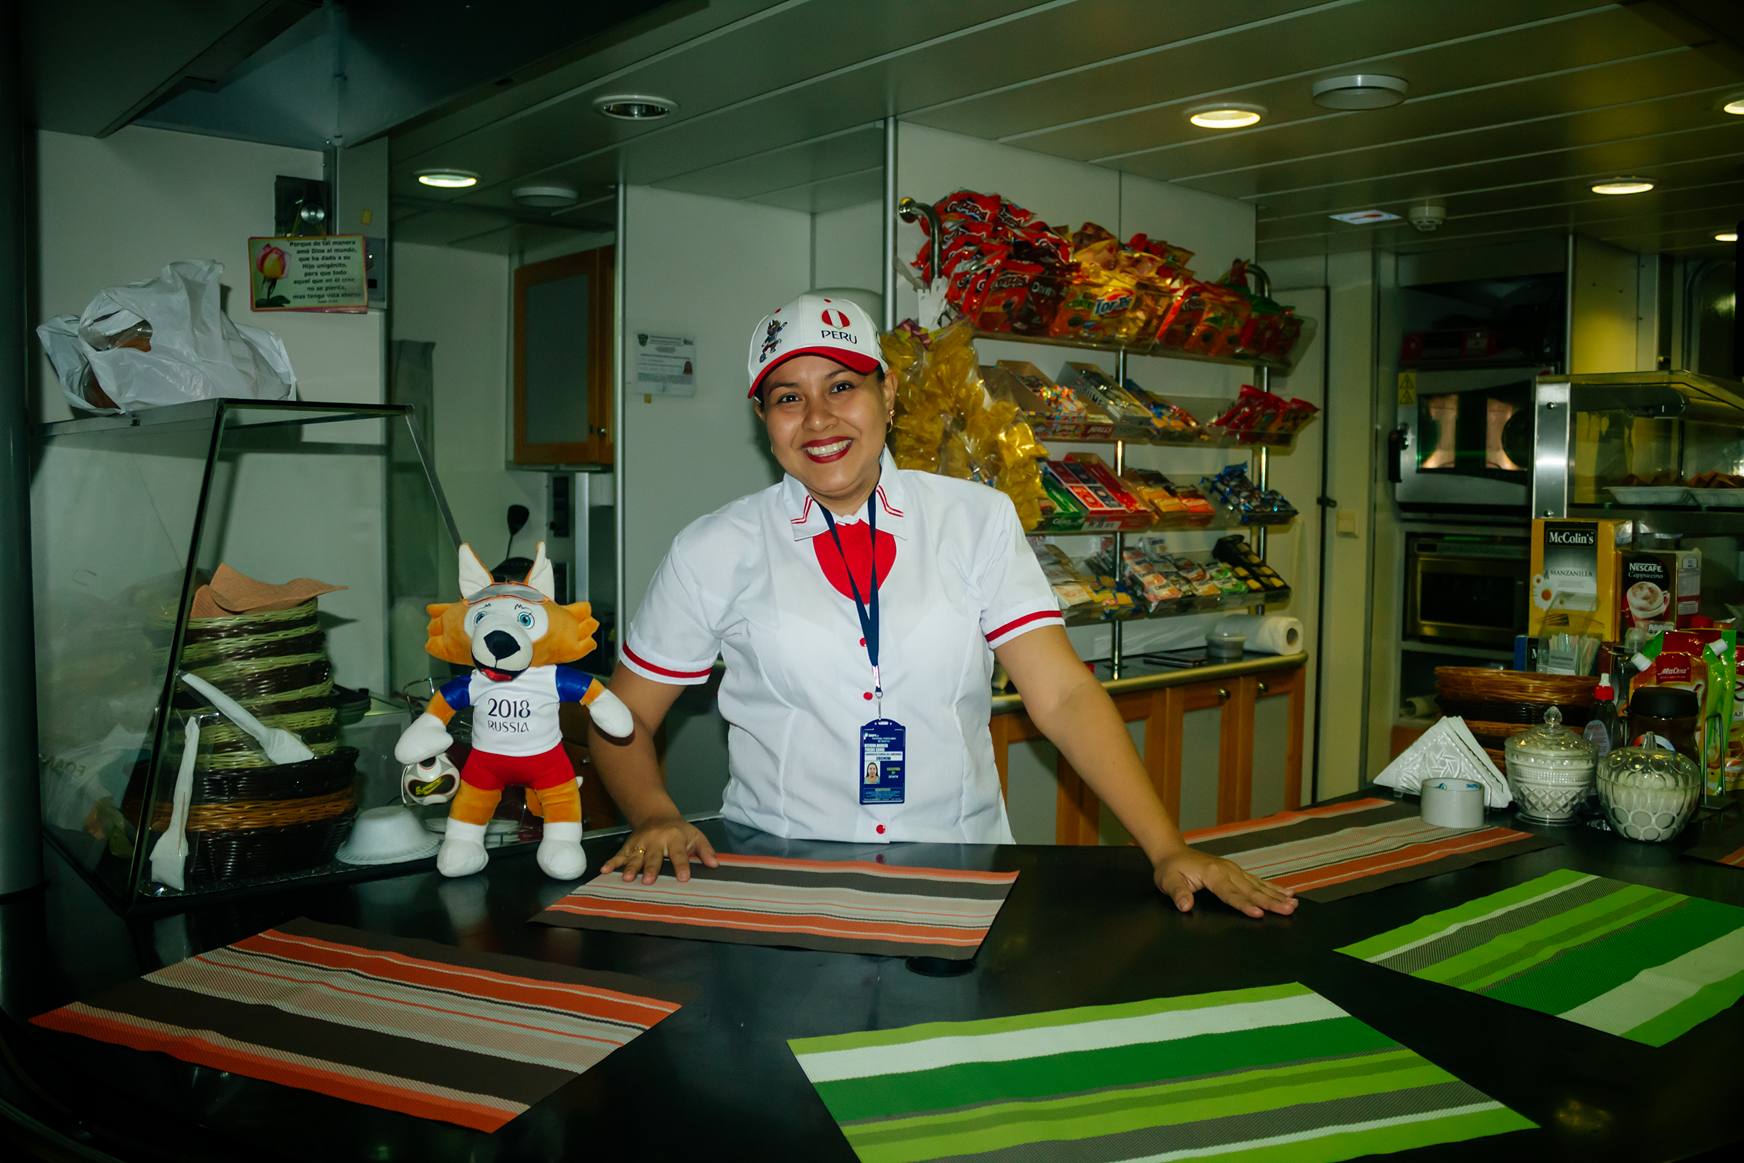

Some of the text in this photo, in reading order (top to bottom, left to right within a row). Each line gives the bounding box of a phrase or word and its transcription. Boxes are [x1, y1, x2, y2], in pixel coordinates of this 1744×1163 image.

[821, 330, 858, 344] PERU
[1549, 532, 1594, 544] McColin's
[488, 698, 531, 718] 2018
[488, 720, 530, 733] RUSSIA
